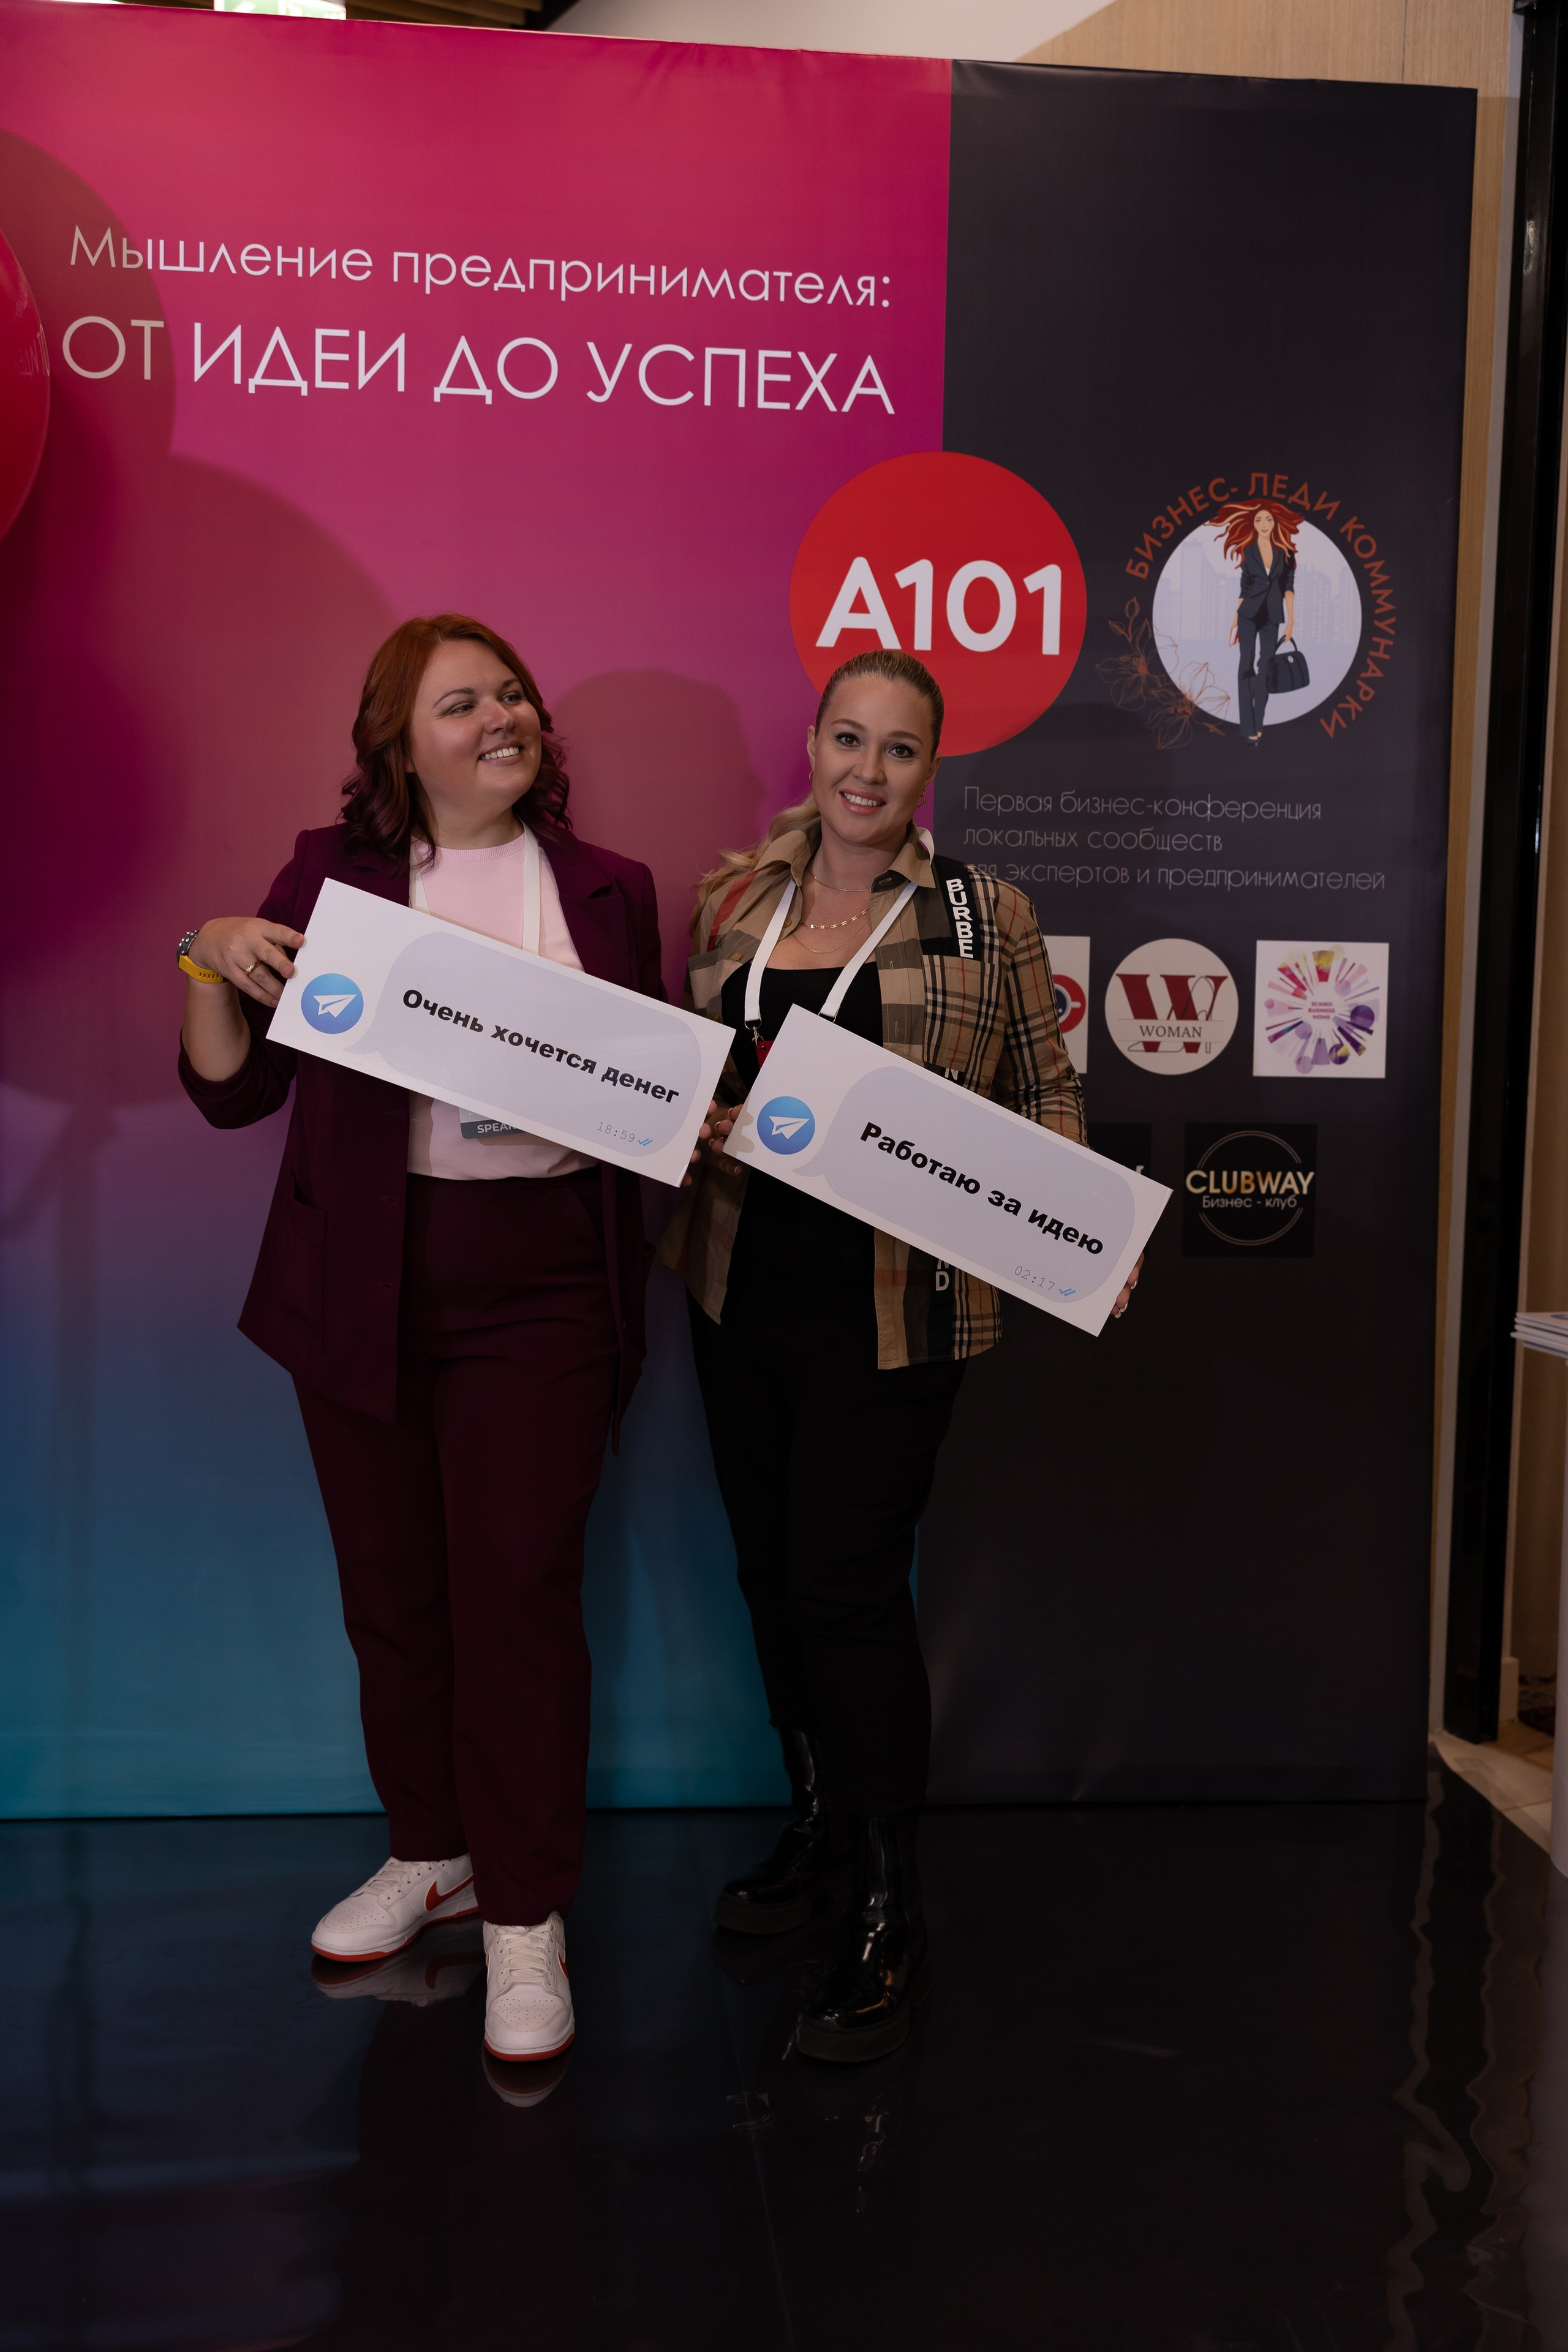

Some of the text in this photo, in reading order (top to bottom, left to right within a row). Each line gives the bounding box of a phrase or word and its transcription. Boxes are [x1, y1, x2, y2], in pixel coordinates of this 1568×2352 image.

[70, 224, 891, 308] Мышление предпринимателя:
[62, 315, 164, 379] ОТ
[194, 322, 405, 396] ИДЕИ
[433, 335, 558, 405] ДО
[586, 341, 895, 415] УСПЕХА
[1248, 472, 1340, 521] ЛЕДИ
[1319, 515, 1397, 739] КОММУНАРКИ
[964, 786, 1321, 823] Первая бизнес-конференция
[963, 827, 1223, 851] локальных сообществ
[1005, 864, 1130, 888] экспертов
[1137, 868, 1150, 884] и
[1158, 868, 1385, 891] предпринимателей
[946, 878, 974, 959] BURBE
[402, 989, 679, 1104] Очень хочется денег
[1139, 1025, 1202, 1038] WOMAN
[597, 1121, 635, 1142] 18:59
[860, 1121, 1103, 1254] Работаю за идею
[1185, 1169, 1315, 1195] CLUBWAY
[1202, 1195, 1253, 1208] Бизнес
[1265, 1194, 1298, 1210] клуб
[1014, 1265, 1055, 1291] 02:17
